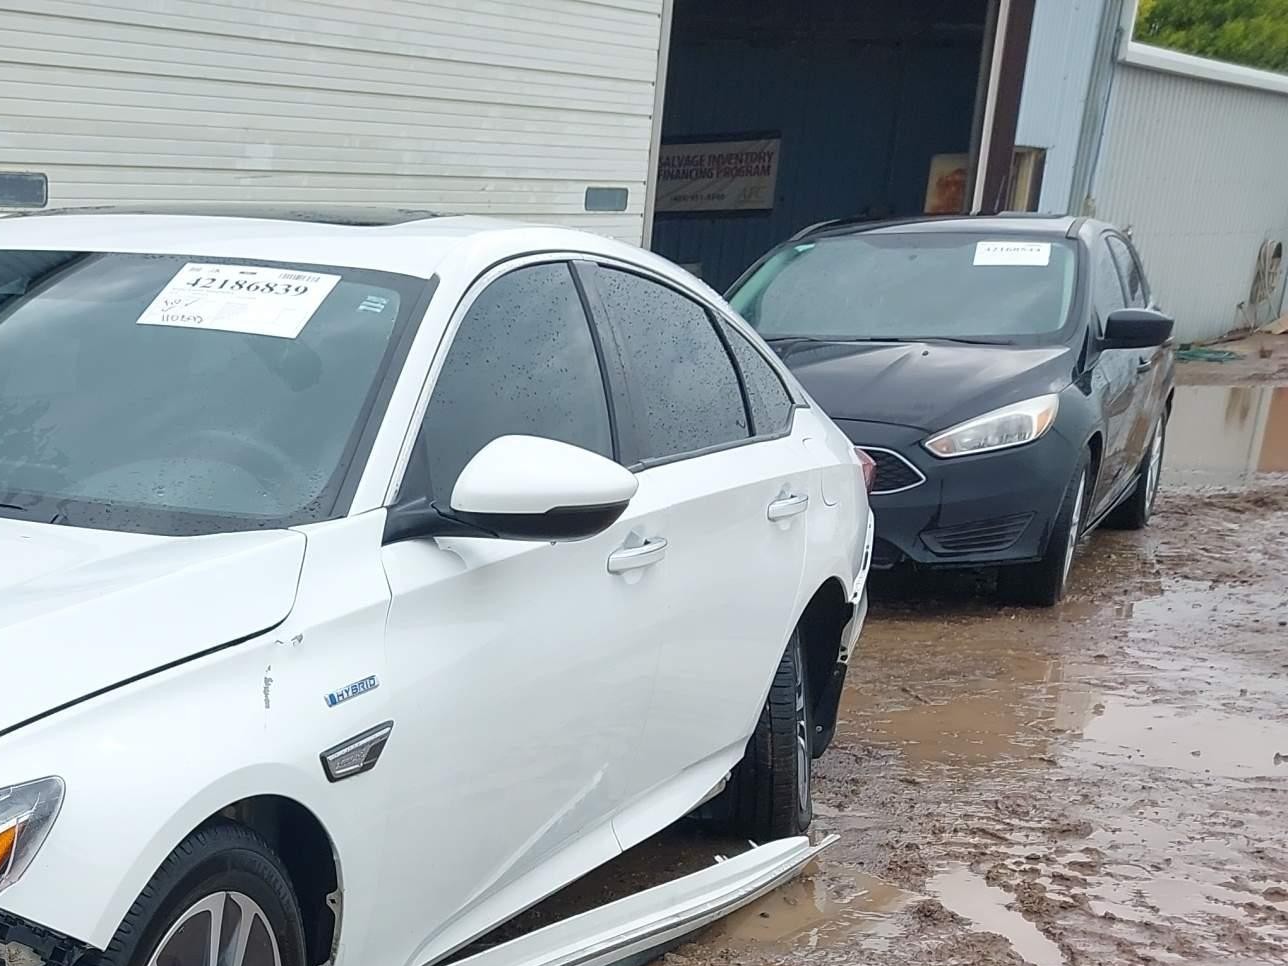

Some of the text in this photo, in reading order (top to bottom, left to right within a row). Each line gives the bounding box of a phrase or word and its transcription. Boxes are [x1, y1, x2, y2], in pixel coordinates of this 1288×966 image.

[708, 151, 774, 166] INVENTORY
[716, 164, 771, 178] PROGRAM
[186, 276, 308, 297] 42186839
[337, 677, 377, 701] HYBRID
